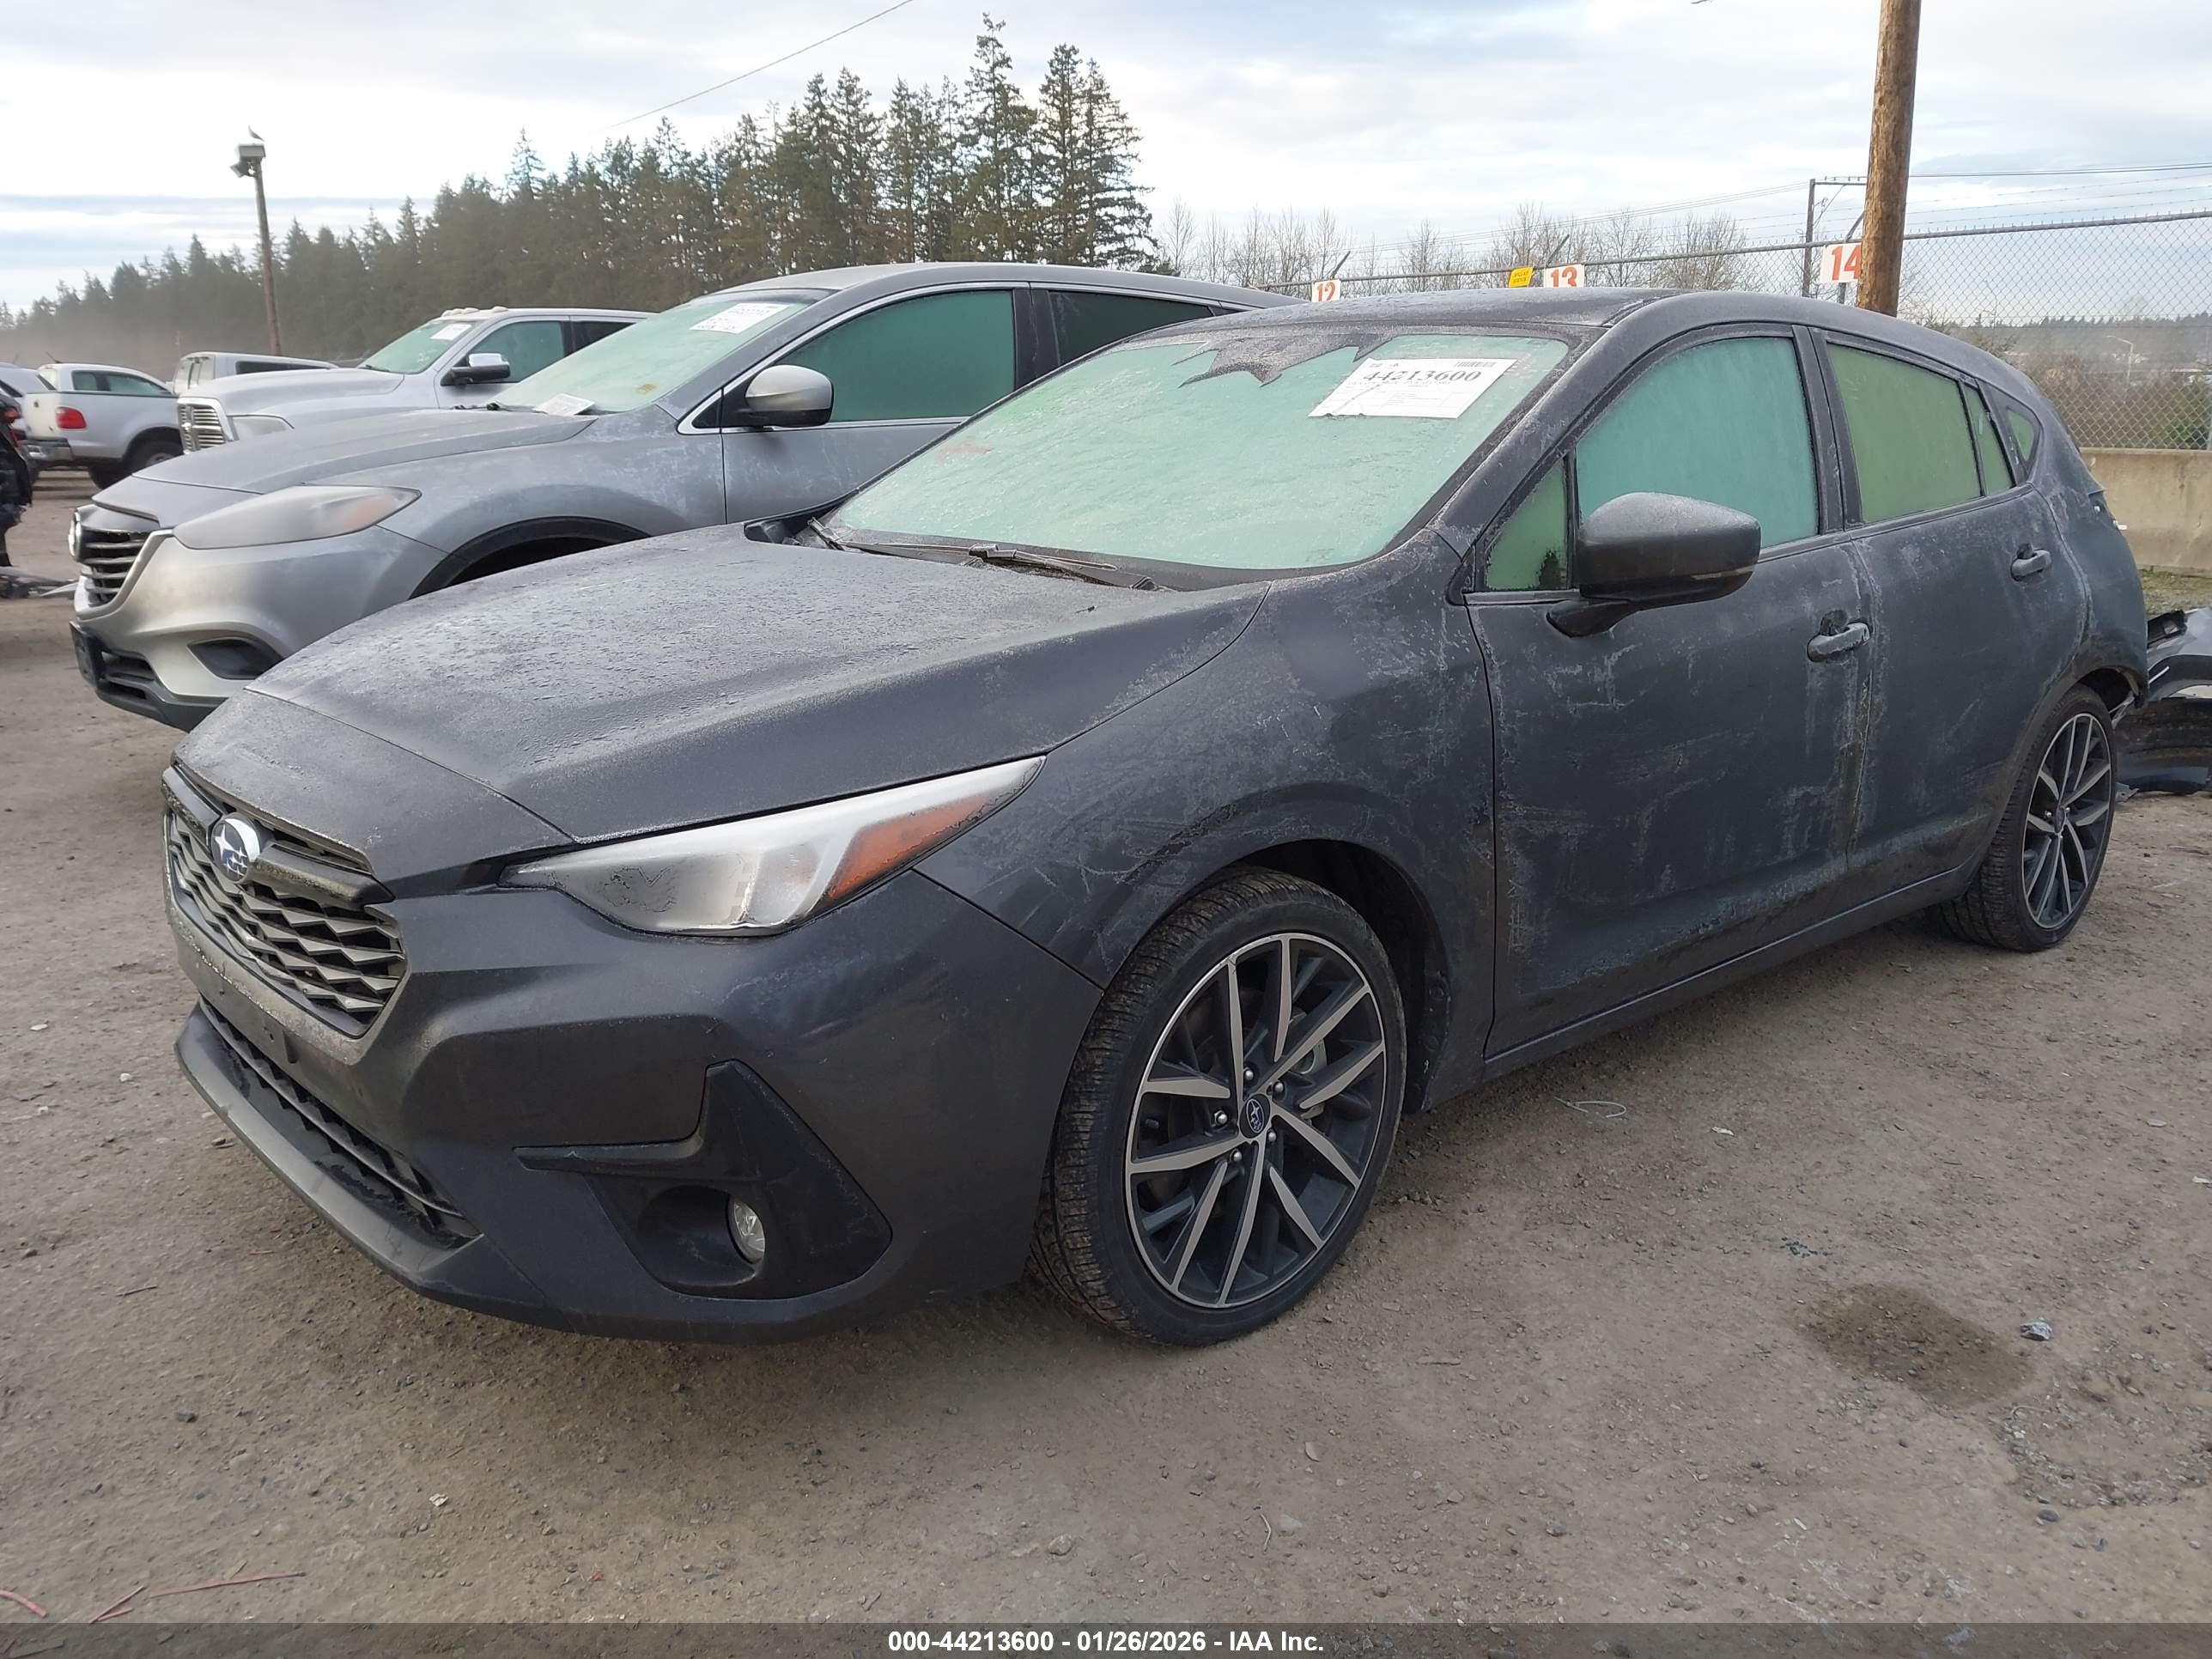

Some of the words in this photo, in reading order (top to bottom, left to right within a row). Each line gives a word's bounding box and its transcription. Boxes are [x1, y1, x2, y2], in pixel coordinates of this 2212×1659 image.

[1831, 246, 1863, 281] 14
[1551, 266, 1578, 288] 13
[1317, 282, 1336, 302] 12
[1363, 370, 1482, 382] 44213600
